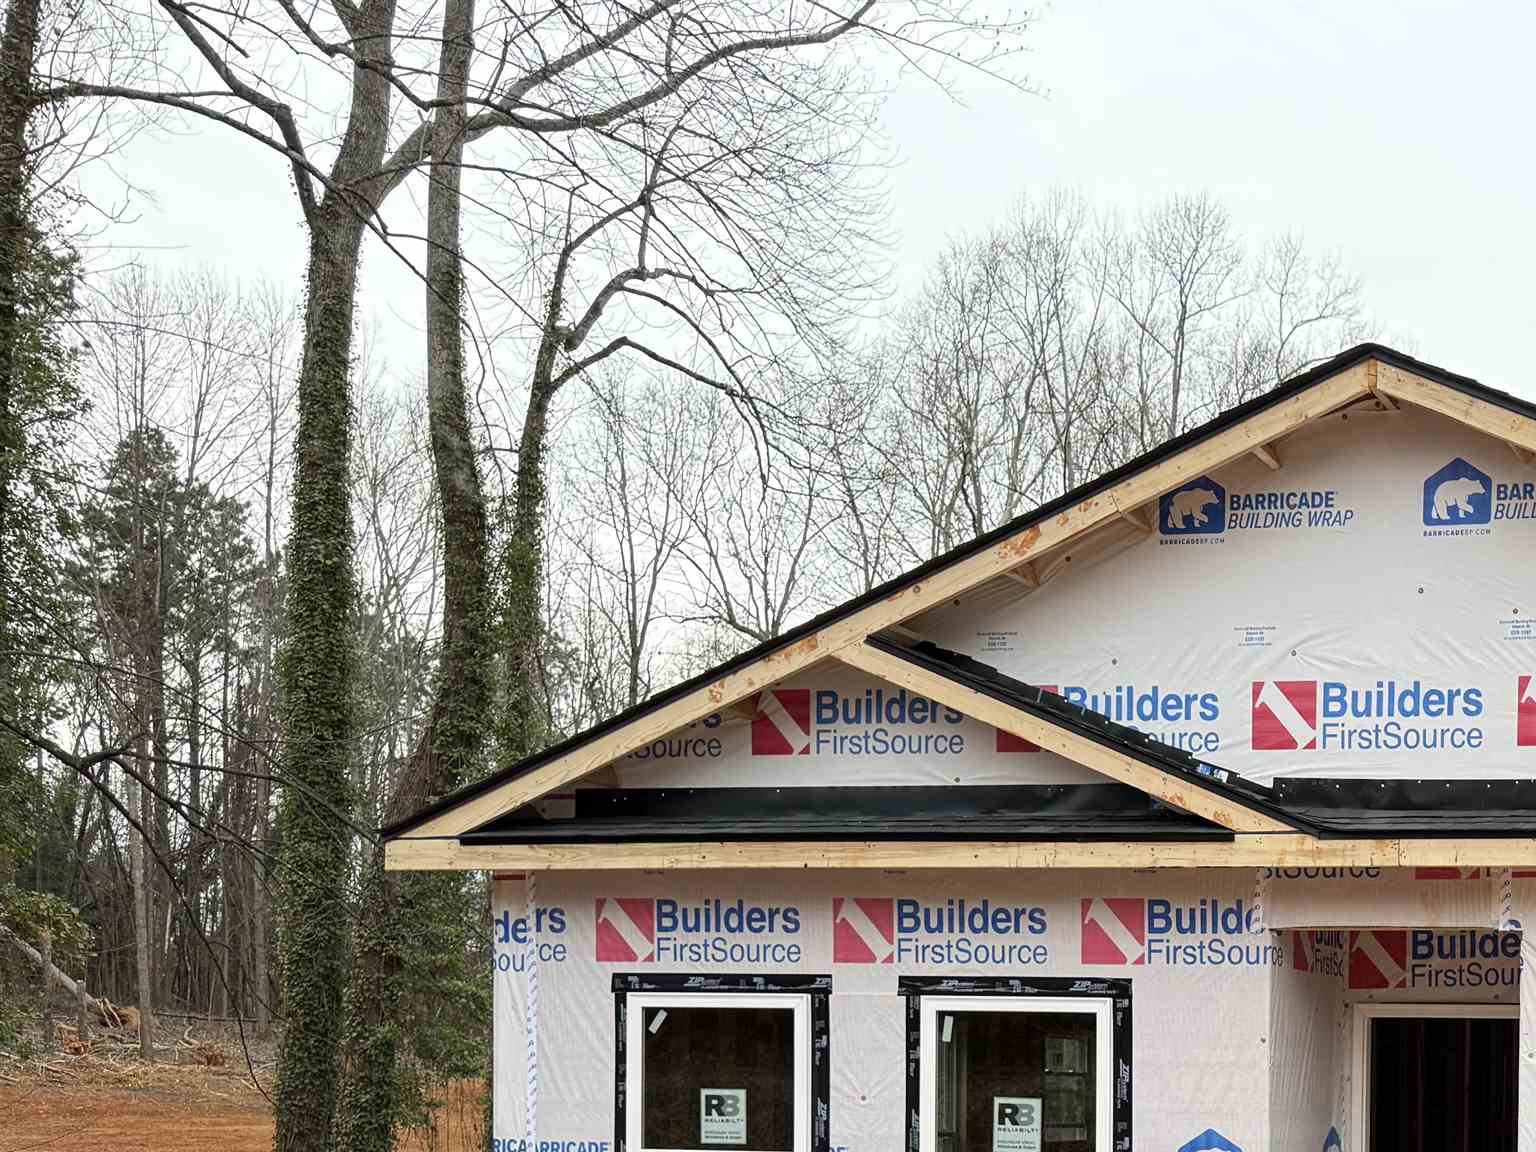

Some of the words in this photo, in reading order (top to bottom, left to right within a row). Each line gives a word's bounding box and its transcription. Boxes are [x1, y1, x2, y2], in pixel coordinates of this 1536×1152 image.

[1229, 491, 1335, 511] BARRICADE
[1227, 511, 1302, 530] BUILDING
[1307, 510, 1354, 528] WRAP
[1321, 680, 1484, 718] Builders
[815, 728, 965, 755] FirstSource
[1321, 719, 1484, 750] FirstSource
[655, 898, 801, 934] Builders
[899, 898, 1048, 935] Builders
[655, 936, 801, 964] FirstSource
[898, 936, 1048, 965] FirstSource
